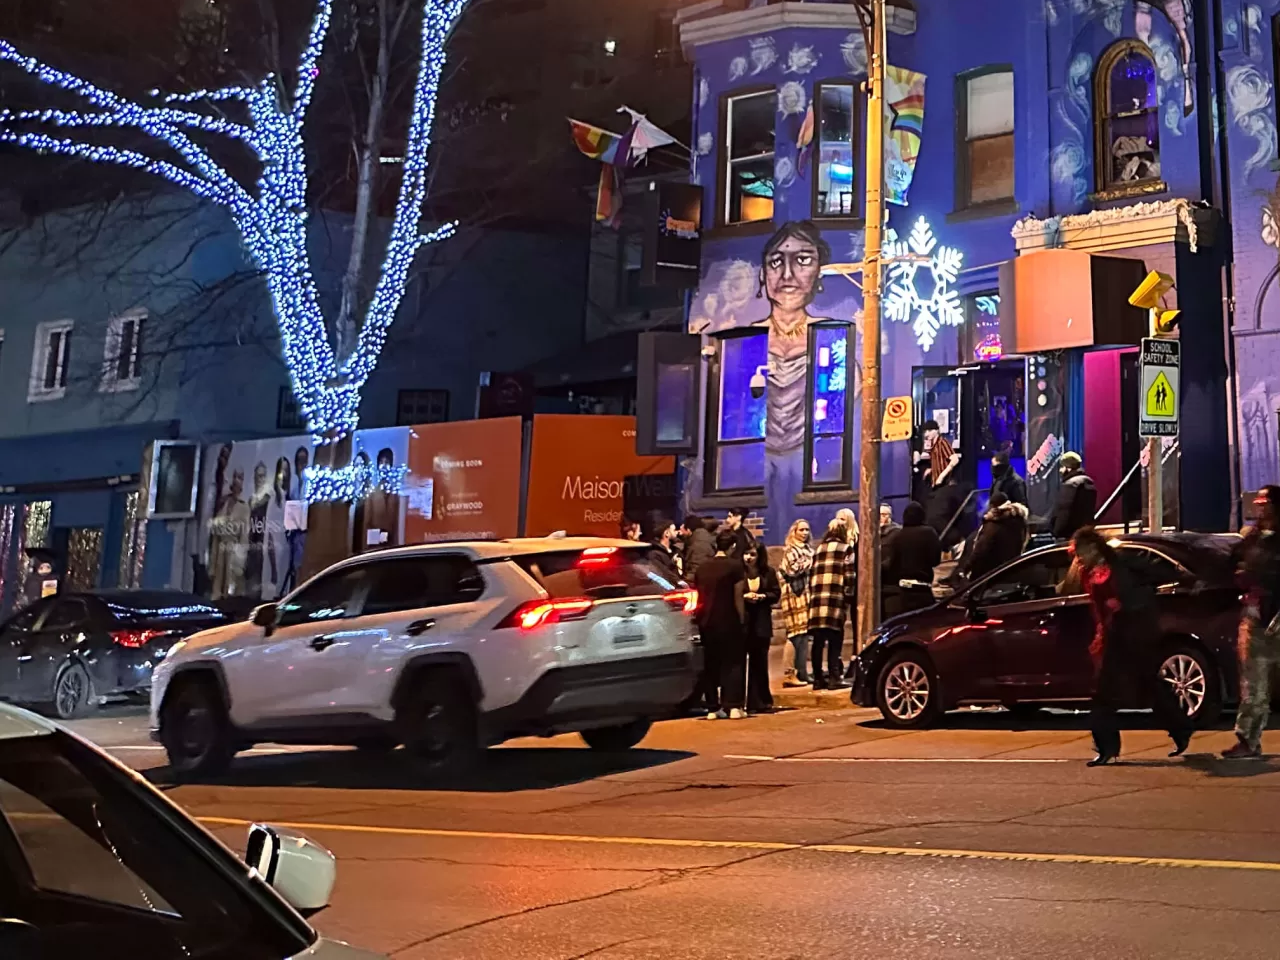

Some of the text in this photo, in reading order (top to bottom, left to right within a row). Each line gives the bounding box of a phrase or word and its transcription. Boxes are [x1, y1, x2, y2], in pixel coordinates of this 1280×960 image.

[980, 346, 1001, 355] OPEN
[1150, 342, 1172, 353] SCHOOL
[1144, 353, 1179, 364] SAFETY ZONE
[1141, 422, 1177, 433] DRIVE SLOWLY
[561, 475, 630, 500] Maison
